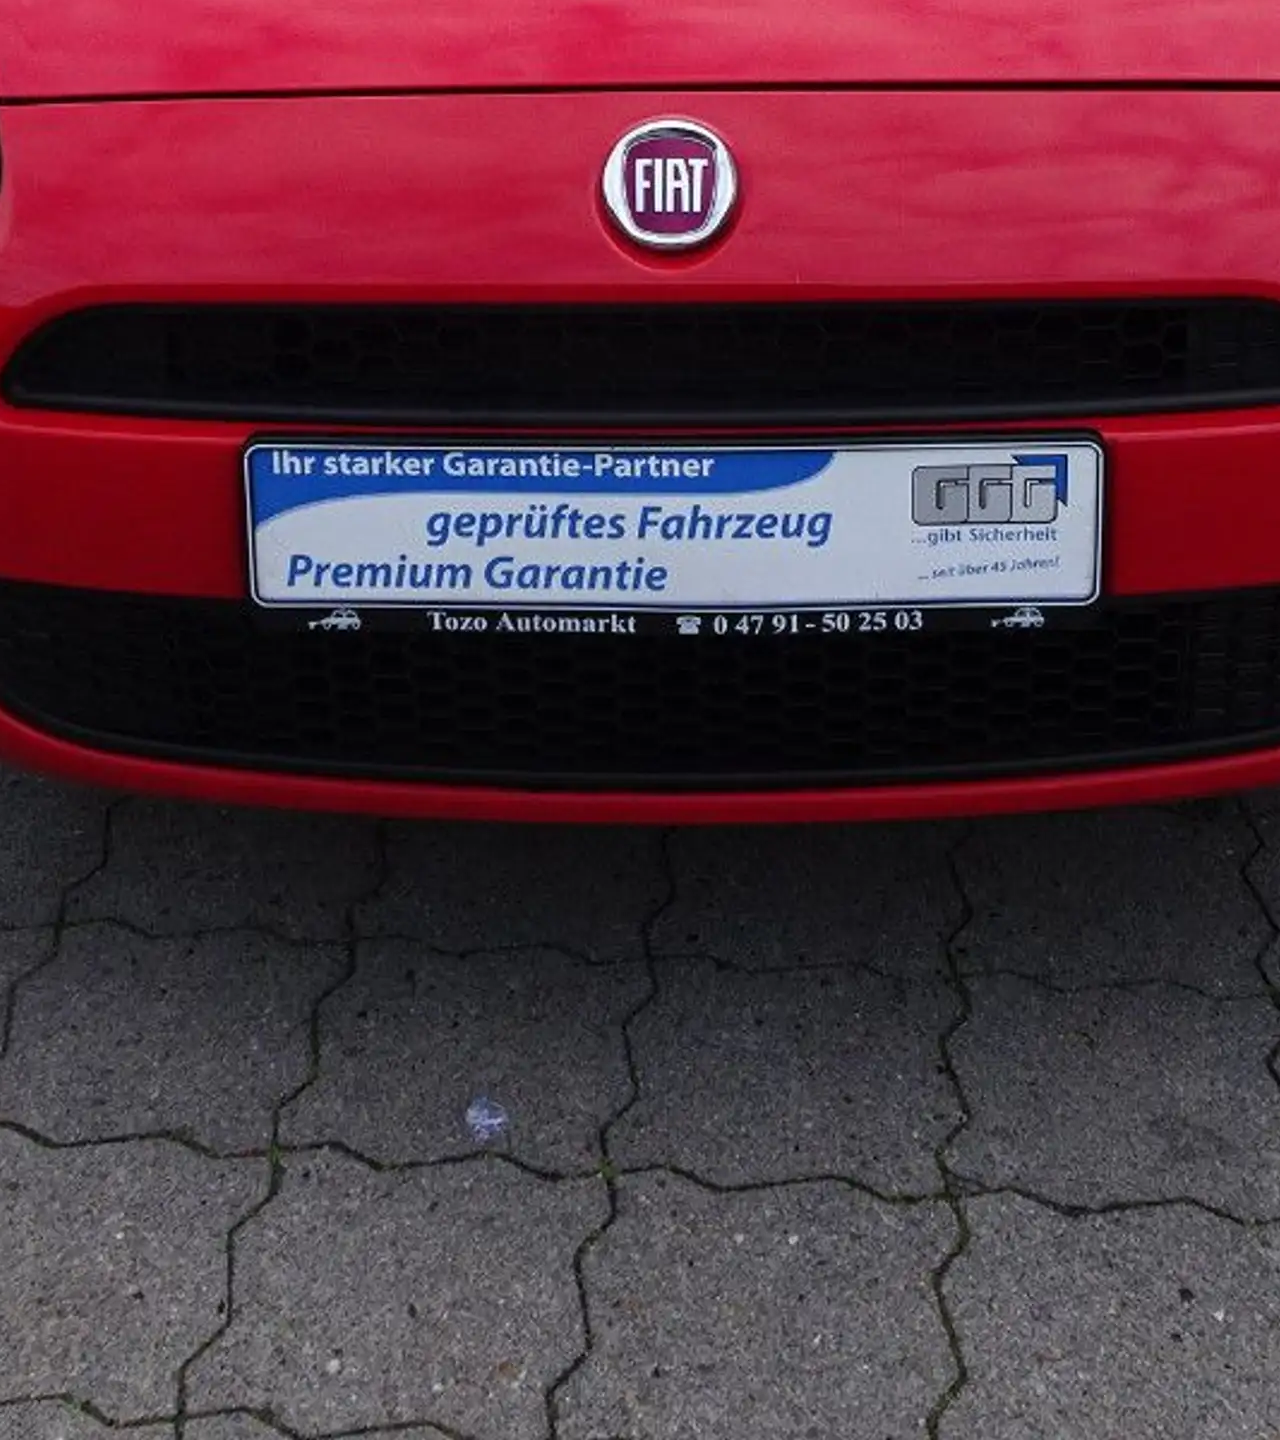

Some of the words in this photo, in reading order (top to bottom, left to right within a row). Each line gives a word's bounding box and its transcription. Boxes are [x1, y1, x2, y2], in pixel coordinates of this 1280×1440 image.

[634, 158, 709, 213] FIAT
[272, 450, 316, 475] Ihr
[324, 451, 435, 477] starker
[443, 451, 715, 477] Garantie-Partner
[426, 504, 626, 546] geprüftes
[638, 505, 833, 547] Fahrzeug
[969, 527, 1058, 544] Sicherheit
[287, 554, 472, 588] Premium
[484, 557, 668, 591] Garantie
[959, 563, 989, 576] über
[427, 611, 488, 632] Tozo
[496, 611, 636, 633] Automarkt
[714, 615, 728, 636] 0
[735, 615, 768, 635] 47
[772, 613, 799, 633] 91
[822, 612, 850, 632] 50
[859, 611, 888, 631] 25
[895, 611, 924, 631] 03
